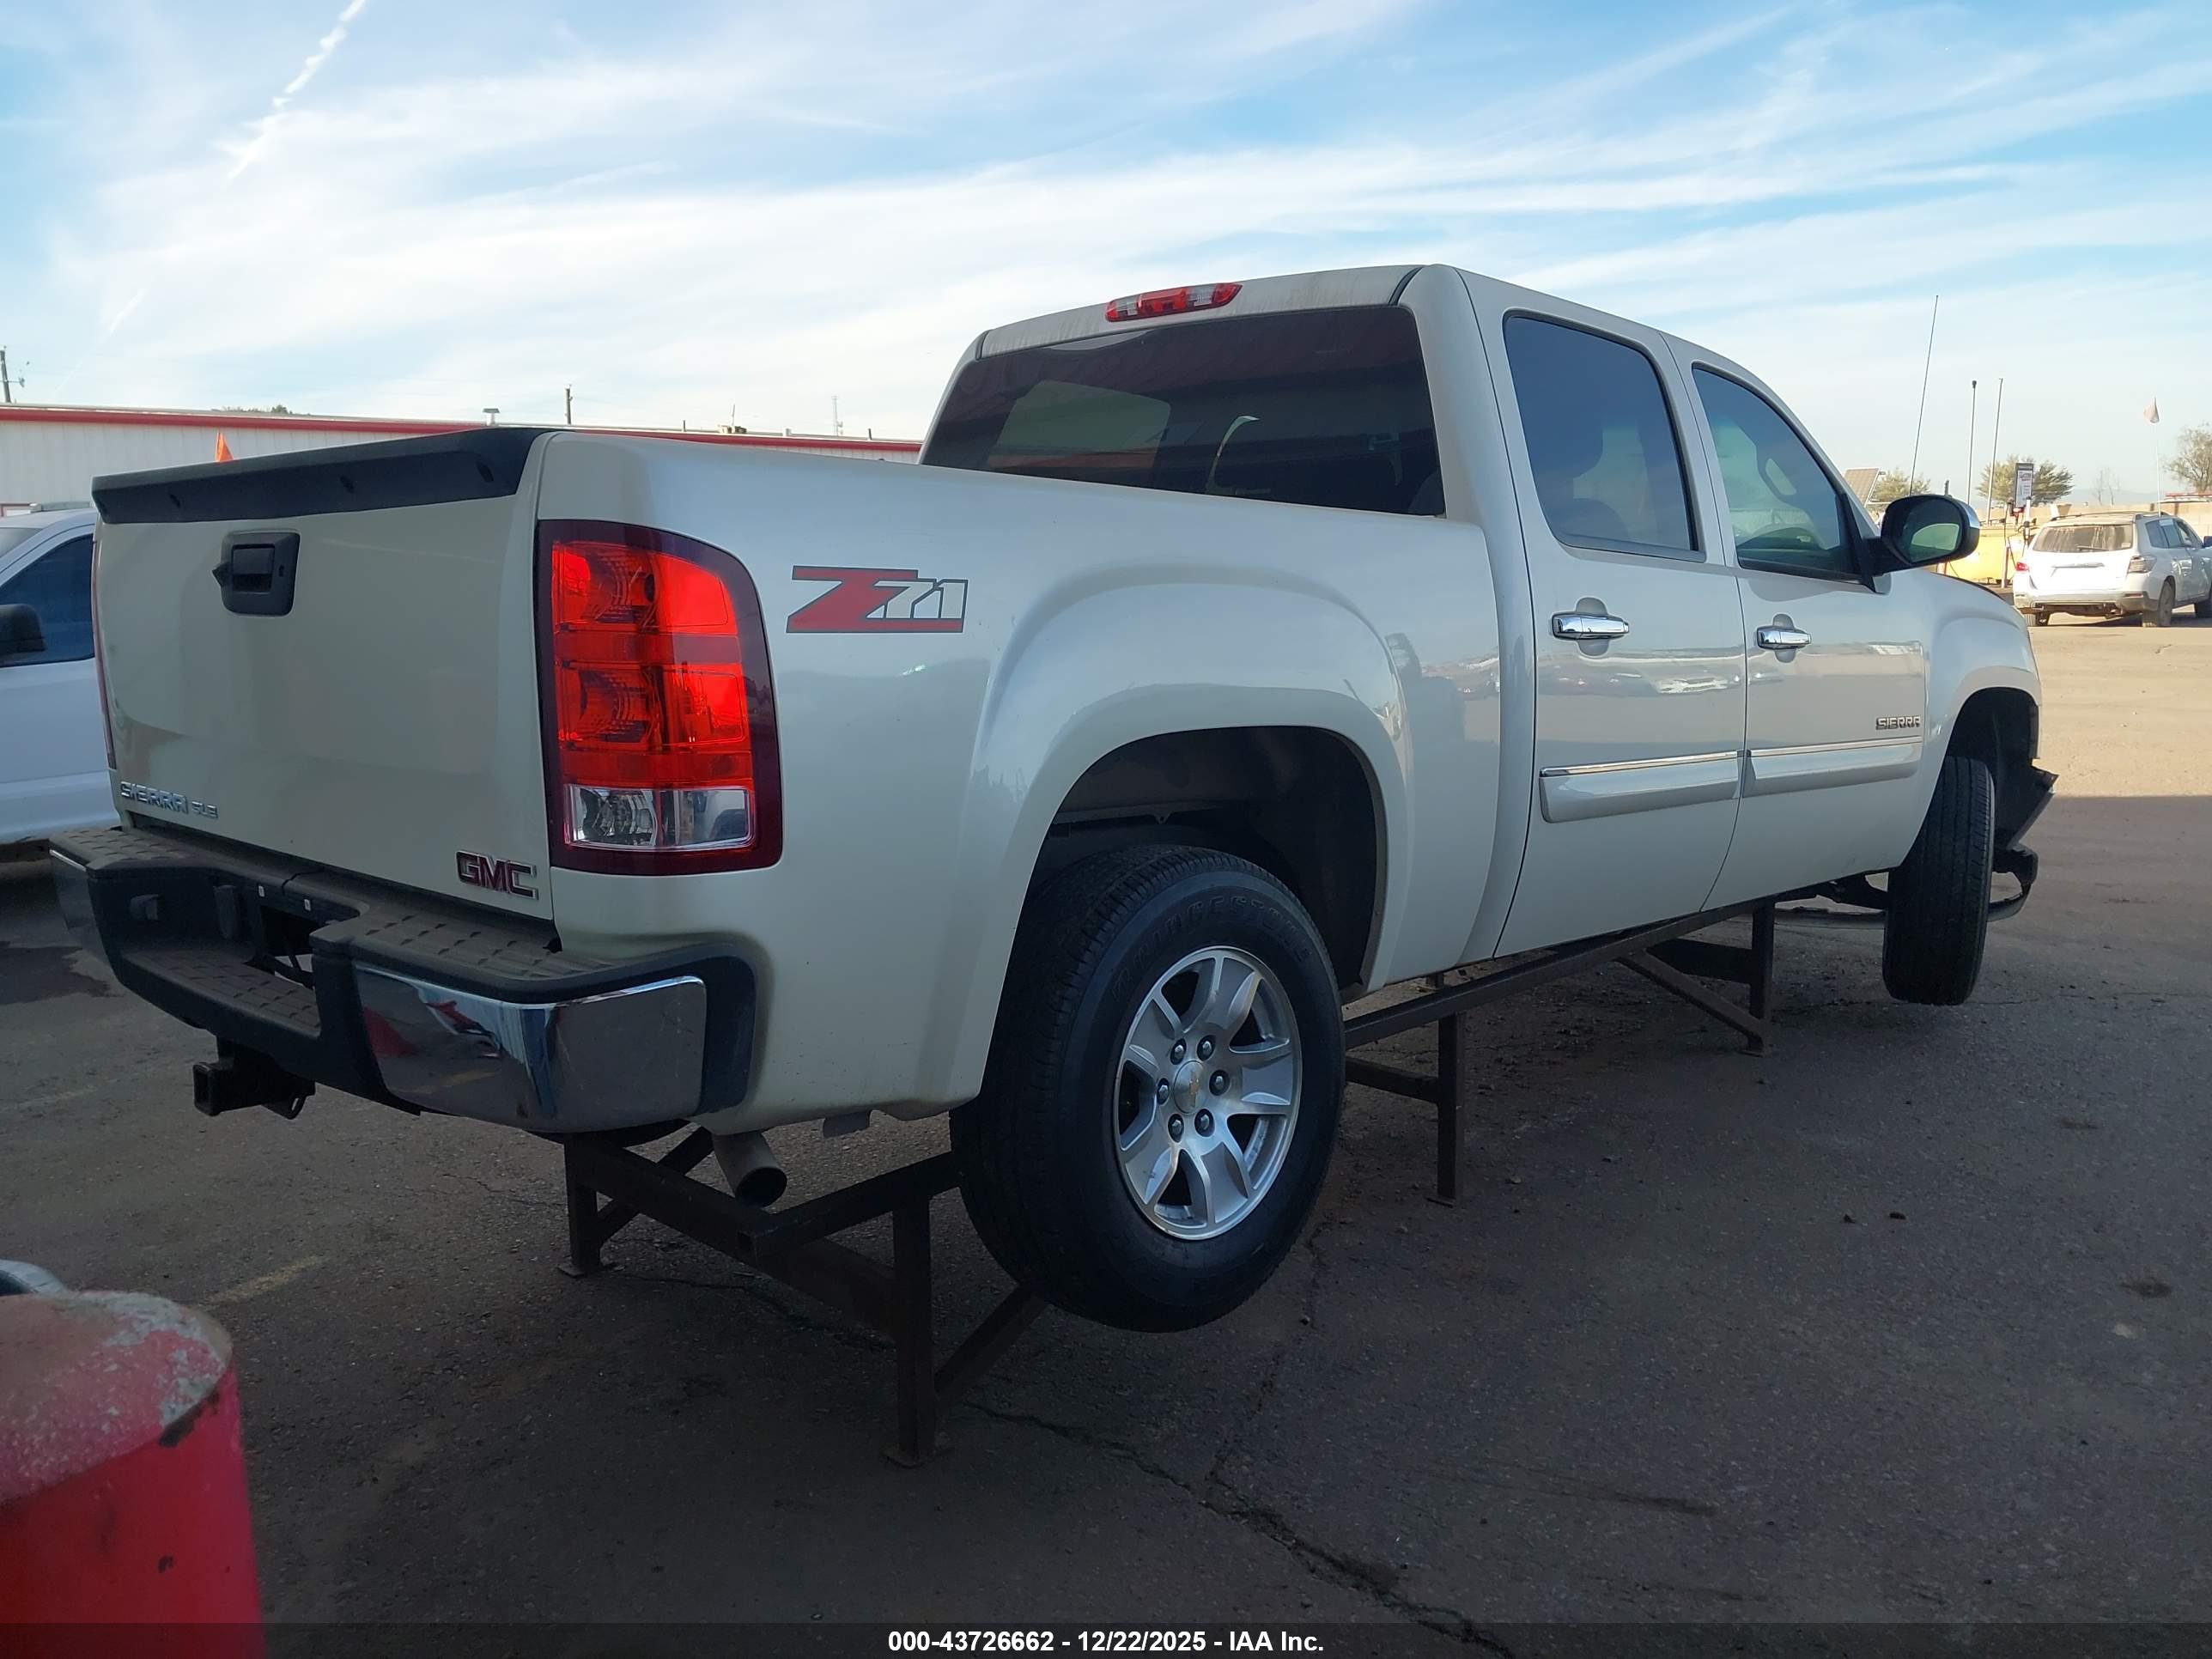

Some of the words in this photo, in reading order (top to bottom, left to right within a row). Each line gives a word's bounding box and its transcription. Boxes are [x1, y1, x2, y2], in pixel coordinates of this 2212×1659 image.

[786, 565, 969, 633] Z71
[1875, 716, 1921, 730] SIERRA
[120, 781, 189, 814] SIERRA
[456, 850, 538, 899] GMC
